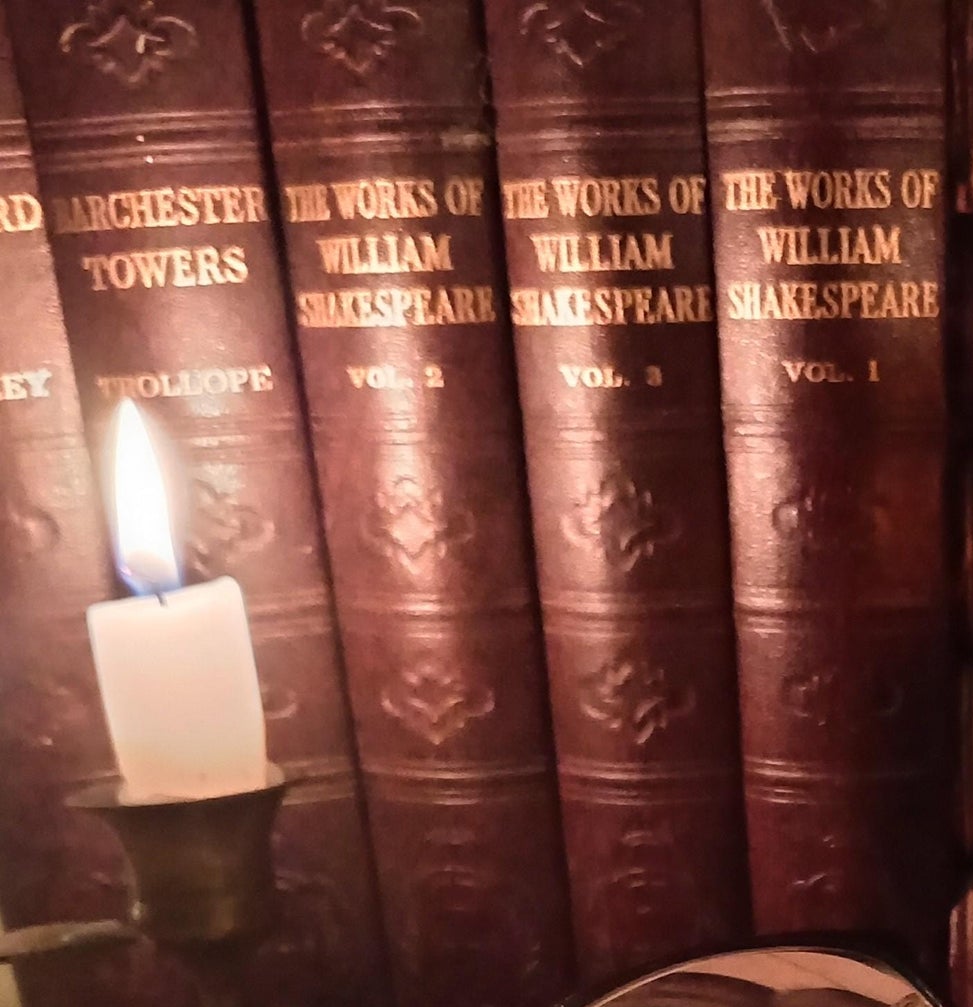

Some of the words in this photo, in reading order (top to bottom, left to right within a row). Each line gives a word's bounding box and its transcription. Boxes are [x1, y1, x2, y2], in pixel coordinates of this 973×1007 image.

[285, 184, 330, 223] THE
[331, 178, 438, 219] WORKS
[444, 175, 485, 216] OF
[503, 181, 549, 219] THE
[551, 176, 661, 217] WORKS
[669, 176, 706, 215] OF
[721, 170, 777, 211] THE
[785, 168, 891, 209] WORKS
[901, 168, 939, 209] OF
[315, 232, 454, 275] WILLIAM
[530, 232, 674, 272] WILLIAM
[757, 226, 902, 266] WILLIAM
[83, 245, 248, 291] TOWERS
[299, 285, 496, 327] SHAKESPEARE
[510, 284, 713, 326] SHAKESPEARE
[727, 280, 939, 321] SHAKESPEARE
[347, 366, 413, 390] VOL.
[425, 366, 445, 389] 2
[558, 364, 630, 388] VOL.
[783, 360, 853, 383] VOL.
[868, 359, 880, 382] 1
